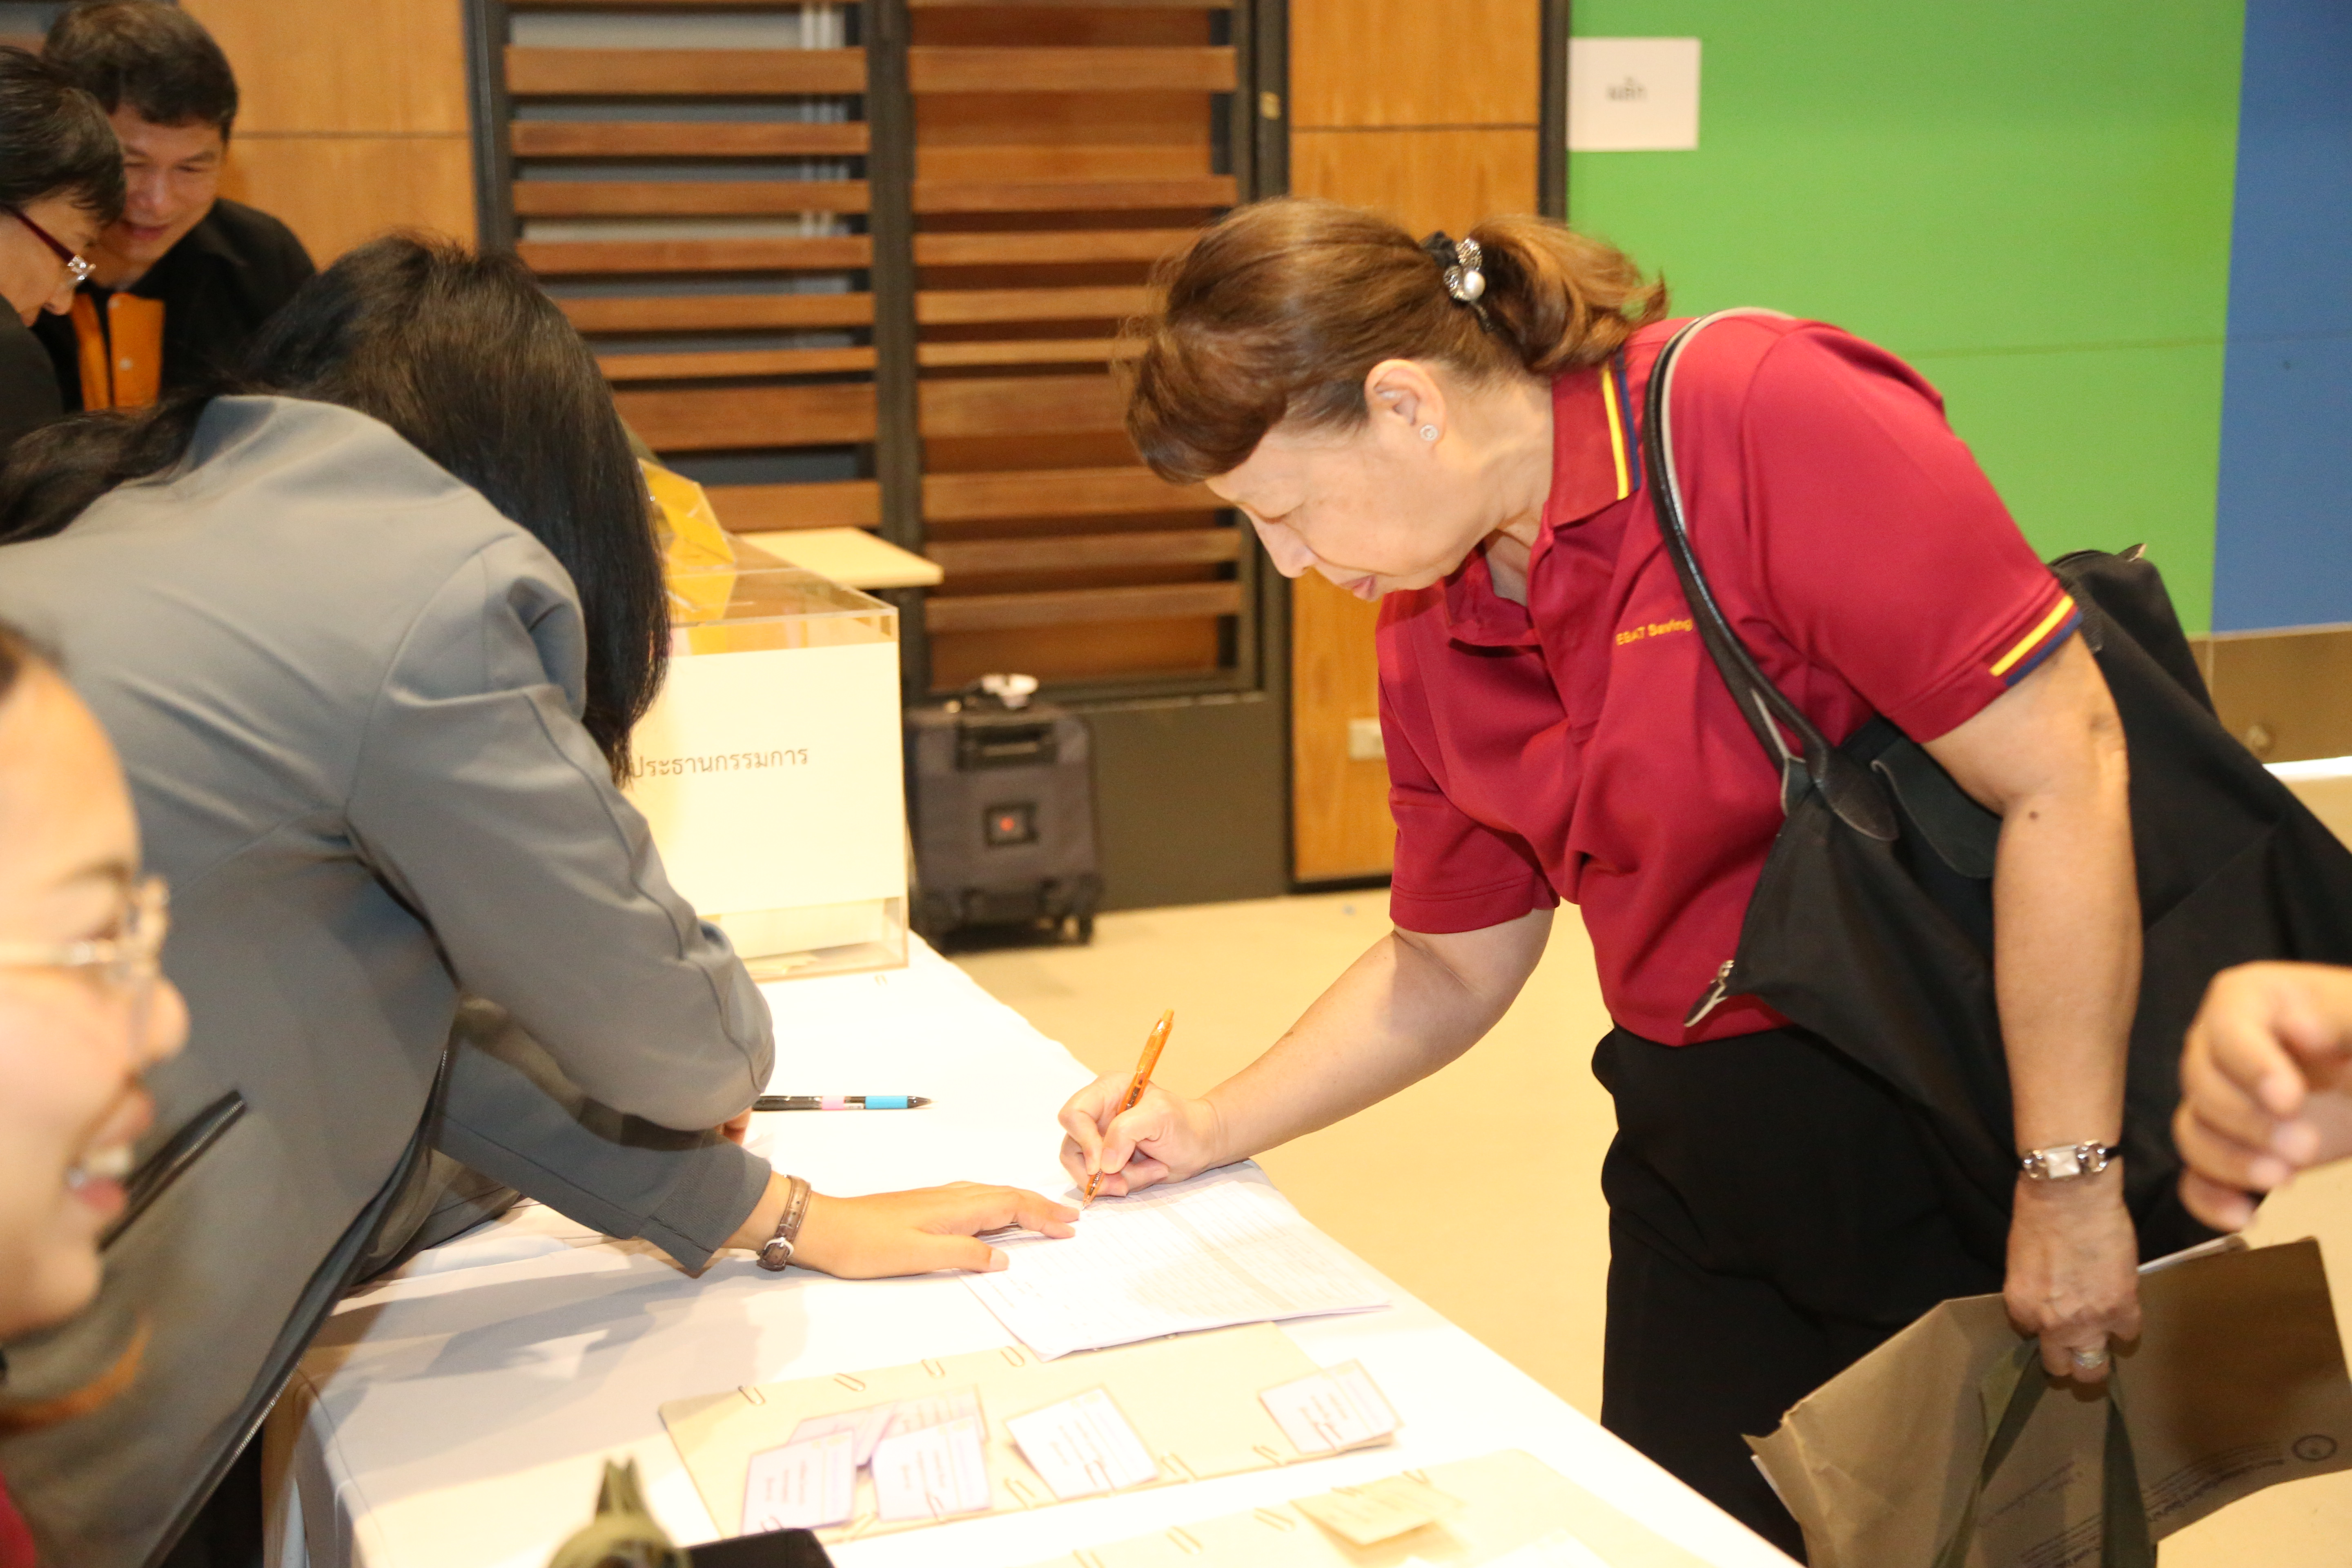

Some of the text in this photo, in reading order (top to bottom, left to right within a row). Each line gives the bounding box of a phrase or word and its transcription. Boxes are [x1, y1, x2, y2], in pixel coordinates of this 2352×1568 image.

[630, 748, 808, 778] ประธานกรรมการ
